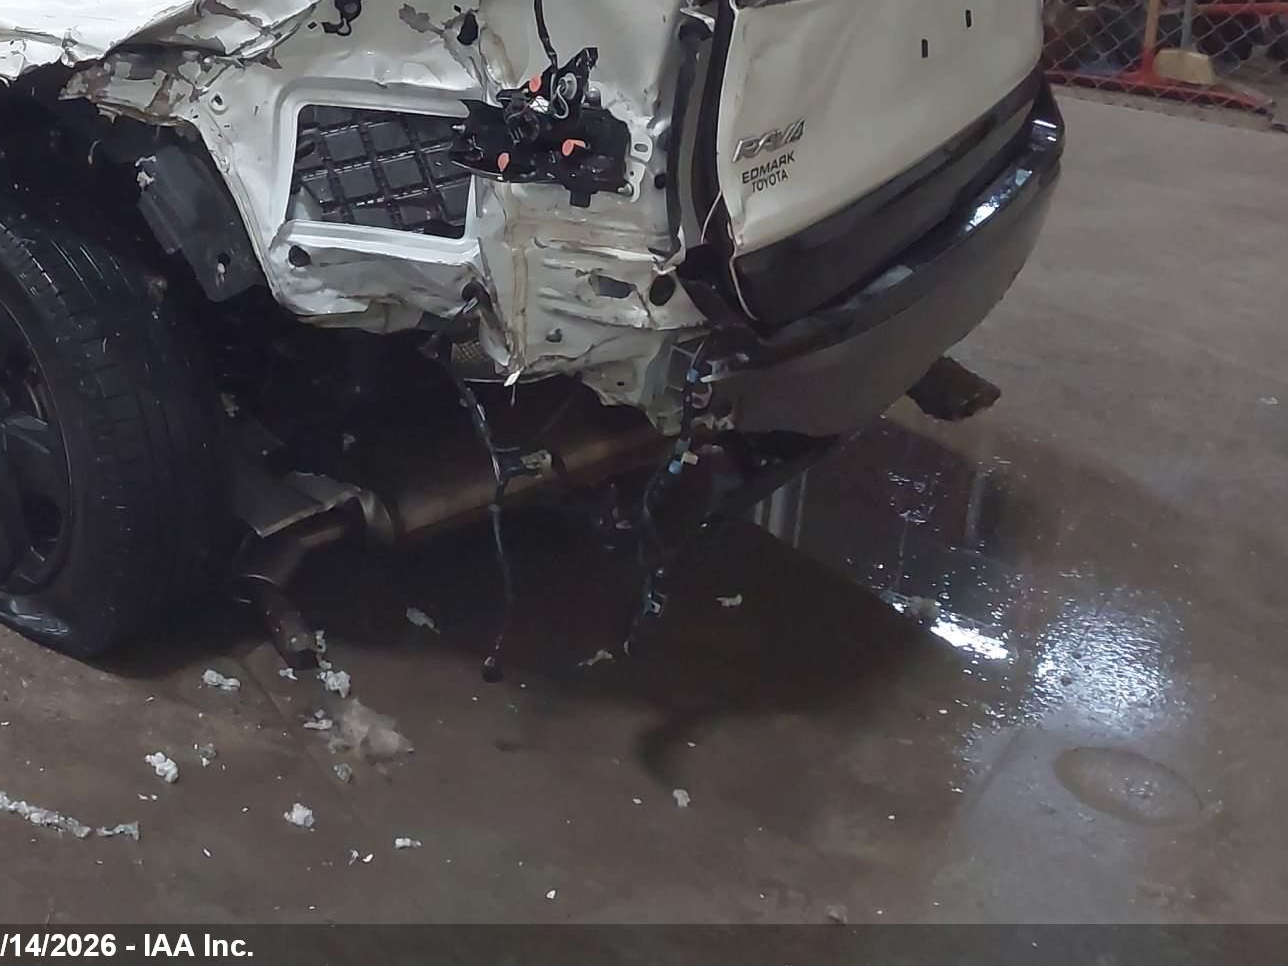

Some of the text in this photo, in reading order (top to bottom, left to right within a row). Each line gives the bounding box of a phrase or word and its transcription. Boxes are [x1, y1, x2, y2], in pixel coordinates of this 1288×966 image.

[732, 119, 805, 163] RAV4
[742, 150, 795, 184] EDMARK
[752, 169, 788, 192] TOYOTA
